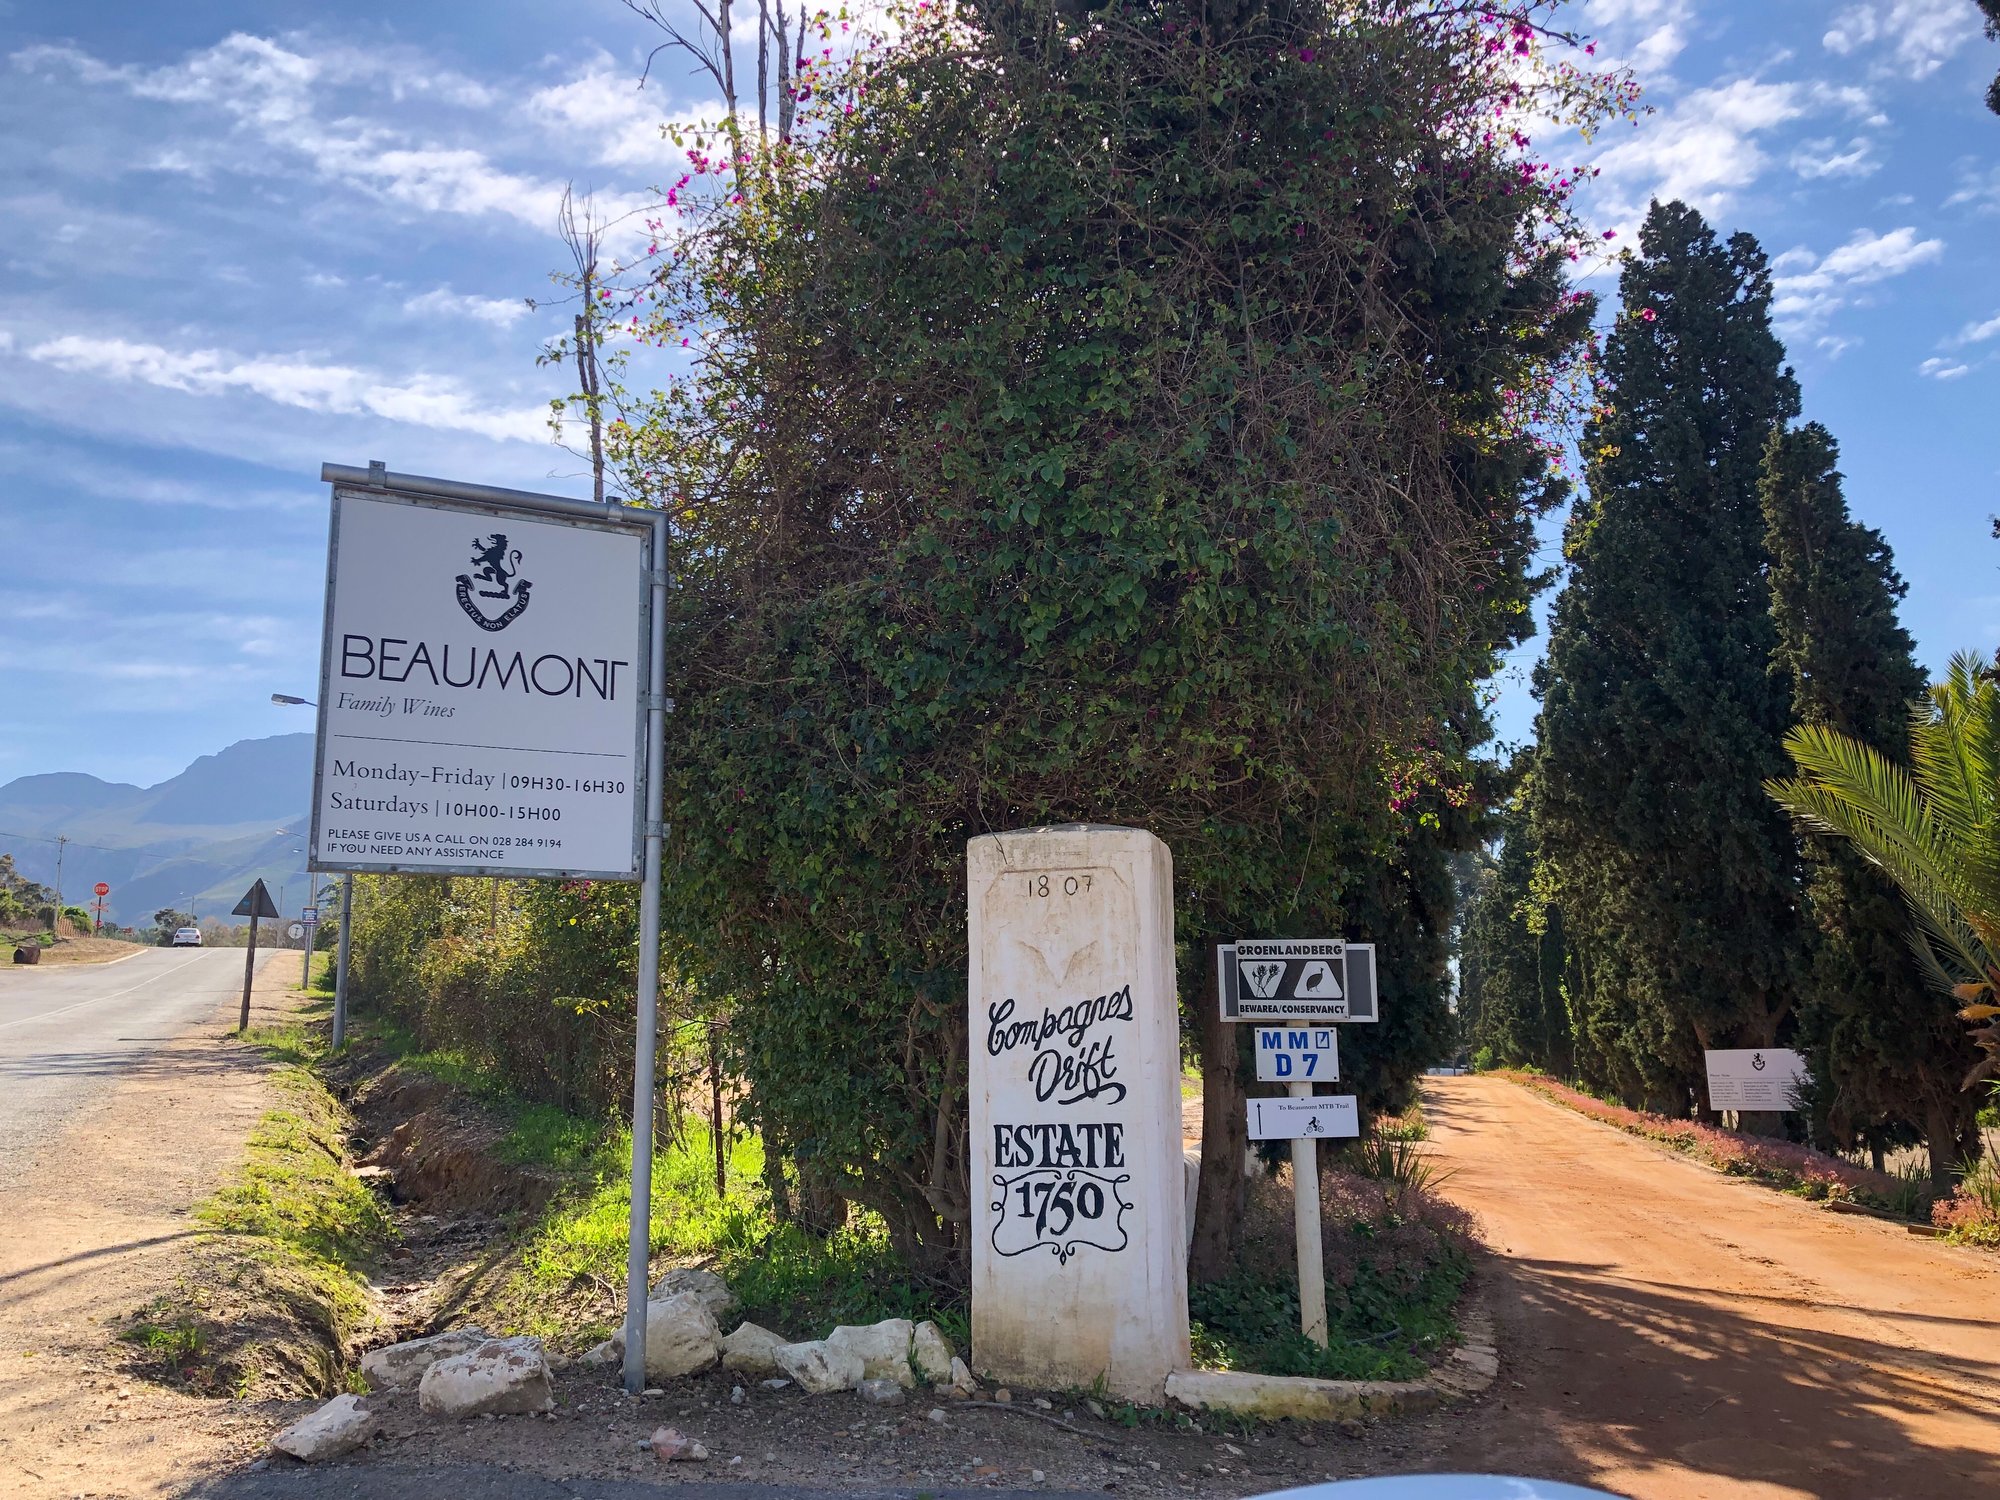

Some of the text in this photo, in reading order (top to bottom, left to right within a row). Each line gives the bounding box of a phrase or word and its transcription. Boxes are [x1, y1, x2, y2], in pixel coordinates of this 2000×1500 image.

[483, 620, 503, 629] NON
[504, 593, 527, 620] ELATUS
[341, 634, 628, 700] BEAUMONT
[337, 692, 456, 718] Family Wines
[330, 792, 429, 817] Saturdays
[327, 843, 504, 859] IF YOU NEED ANY ASSISTANCE
[328, 829, 562, 849] PLEASE GIVE US A CALL ON 028 284 9194
[1237, 945, 1342, 956] GROENLANDBERG
[987, 984, 1133, 1056] Compagnes
[1240, 1004, 1345, 1014] BEWAREA/CONSERVANCY
[1028, 1035, 1127, 1106] Drift
[994, 1123, 1125, 1168] ESTATE
[1015, 1181, 1105, 1240] 1750
